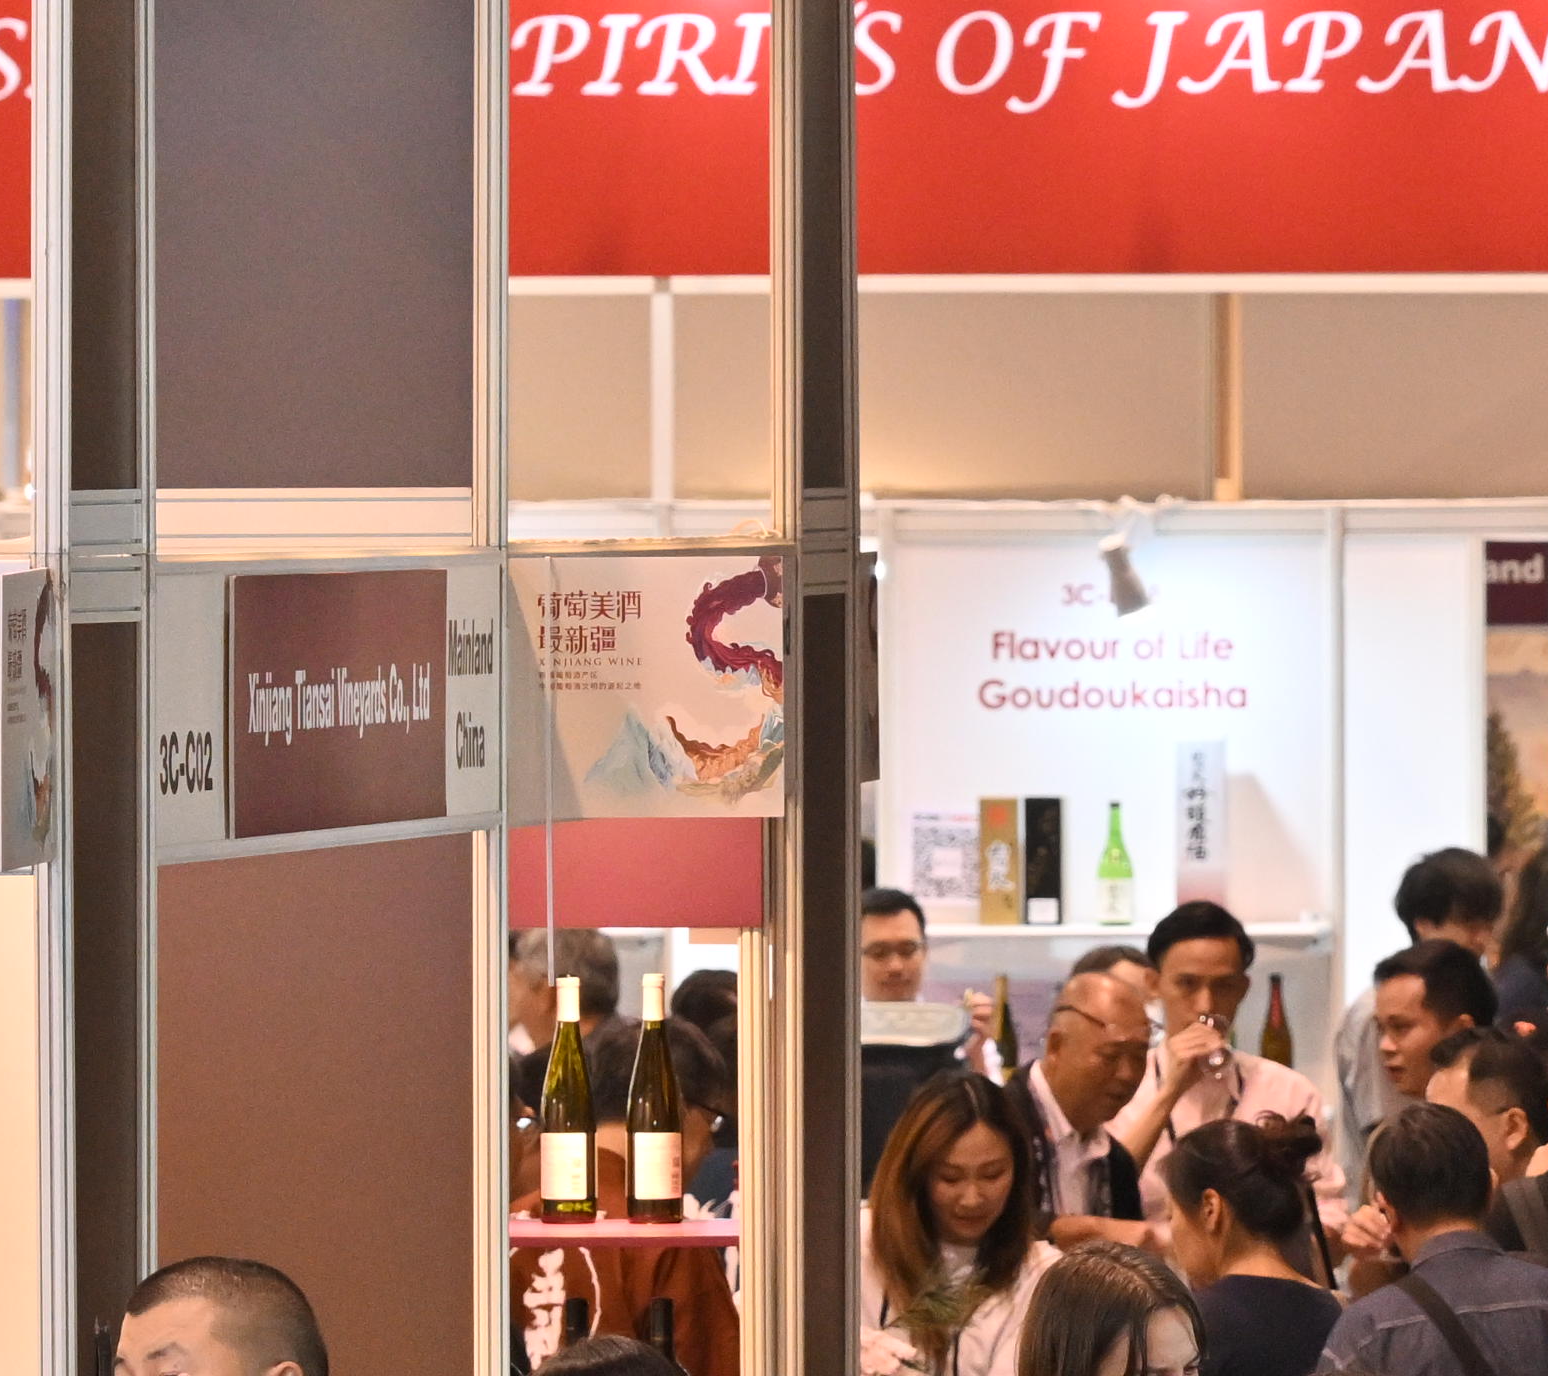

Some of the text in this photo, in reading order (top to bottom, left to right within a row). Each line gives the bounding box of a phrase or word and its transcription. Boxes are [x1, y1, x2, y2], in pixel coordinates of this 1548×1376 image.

[935, 9, 1100, 115] OF
[537, 590, 642, 623] 葡萄美酒
[447, 618, 494, 677] Mainland
[537, 625, 617, 655] 最新疆
[539, 657, 643, 667] XNJIANG WINE
[990, 630, 1120, 660] Flavour
[1177, 630, 1234, 661] Life
[248, 672, 293, 747] Xinjiang
[295, 667, 335, 730] Tiansai
[336, 664, 387, 739] Vineyards
[412, 662, 431, 721] Ltd
[977, 679, 1248, 711] Goudoukaisha
[159, 730, 214, 796] 3C-C02
[456, 711, 486, 770] China
